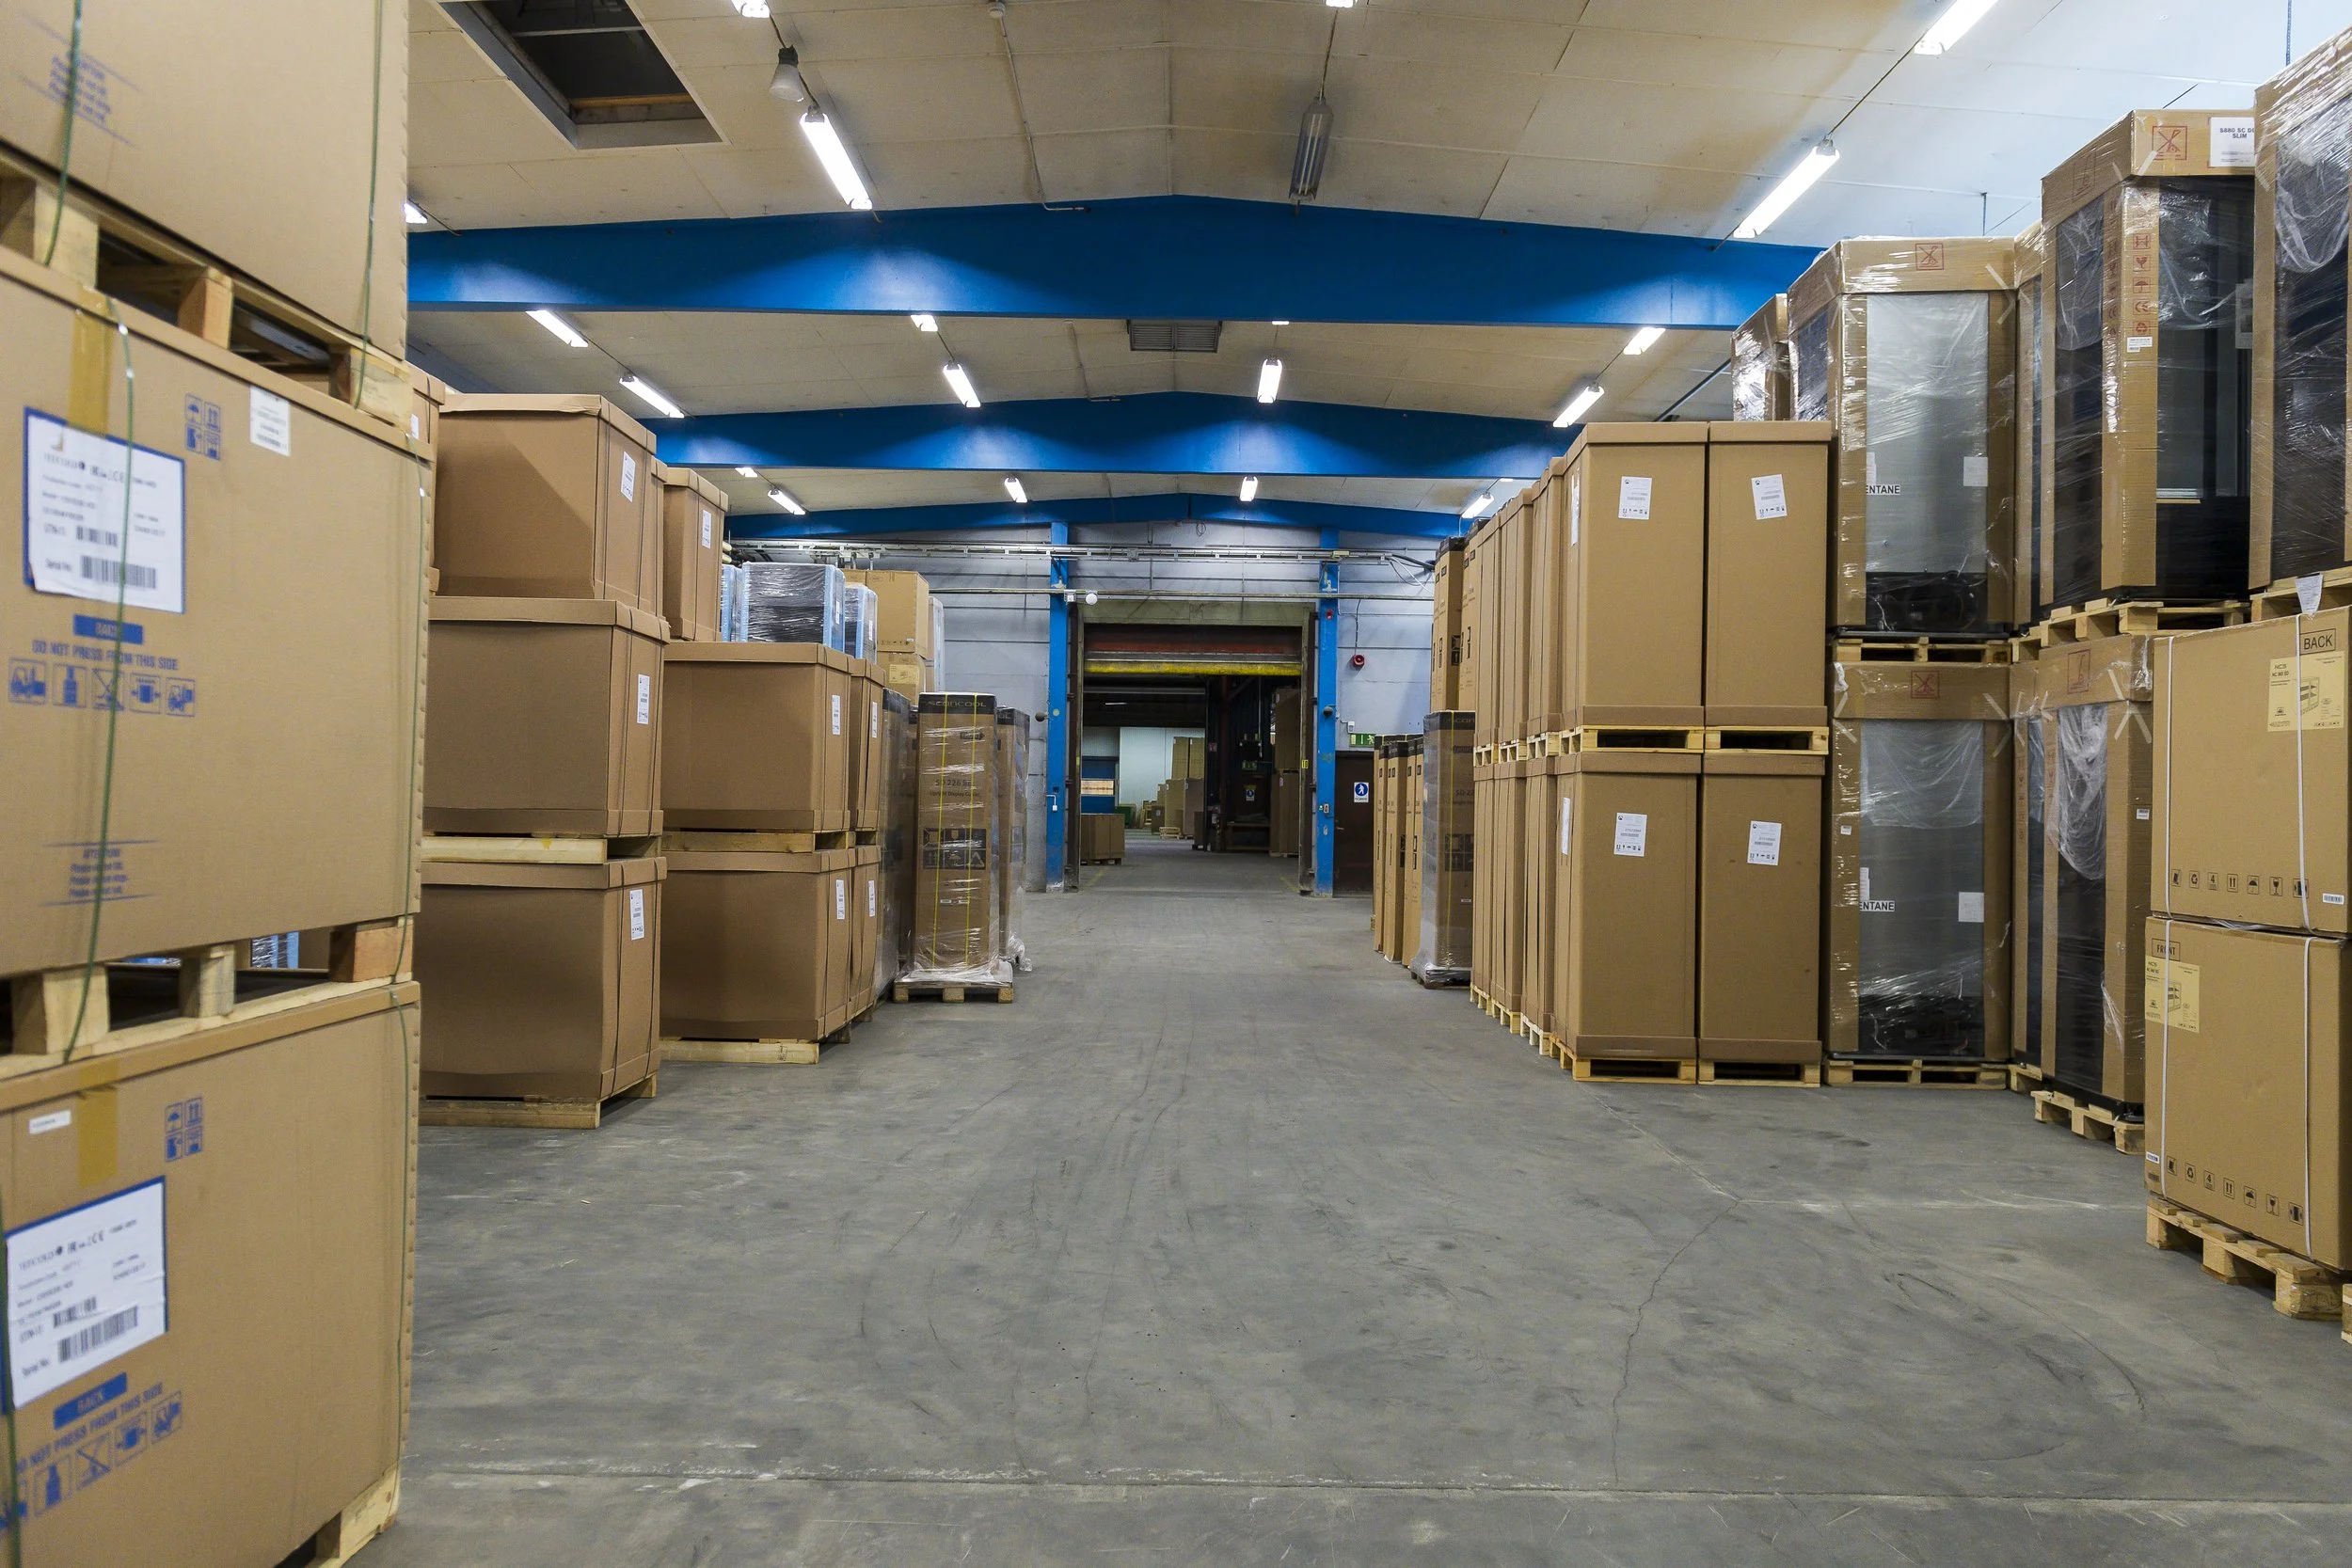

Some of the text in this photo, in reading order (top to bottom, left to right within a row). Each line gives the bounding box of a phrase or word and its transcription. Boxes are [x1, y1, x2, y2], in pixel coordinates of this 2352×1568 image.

[2303, 634, 2333, 650] BACK
[50, 641, 71, 657] NOT
[72, 644, 104, 662] PRESS
[136, 653, 155, 669] THIS
[157, 656, 179, 671] SIDE
[2156, 943, 2176, 956] FRNT
